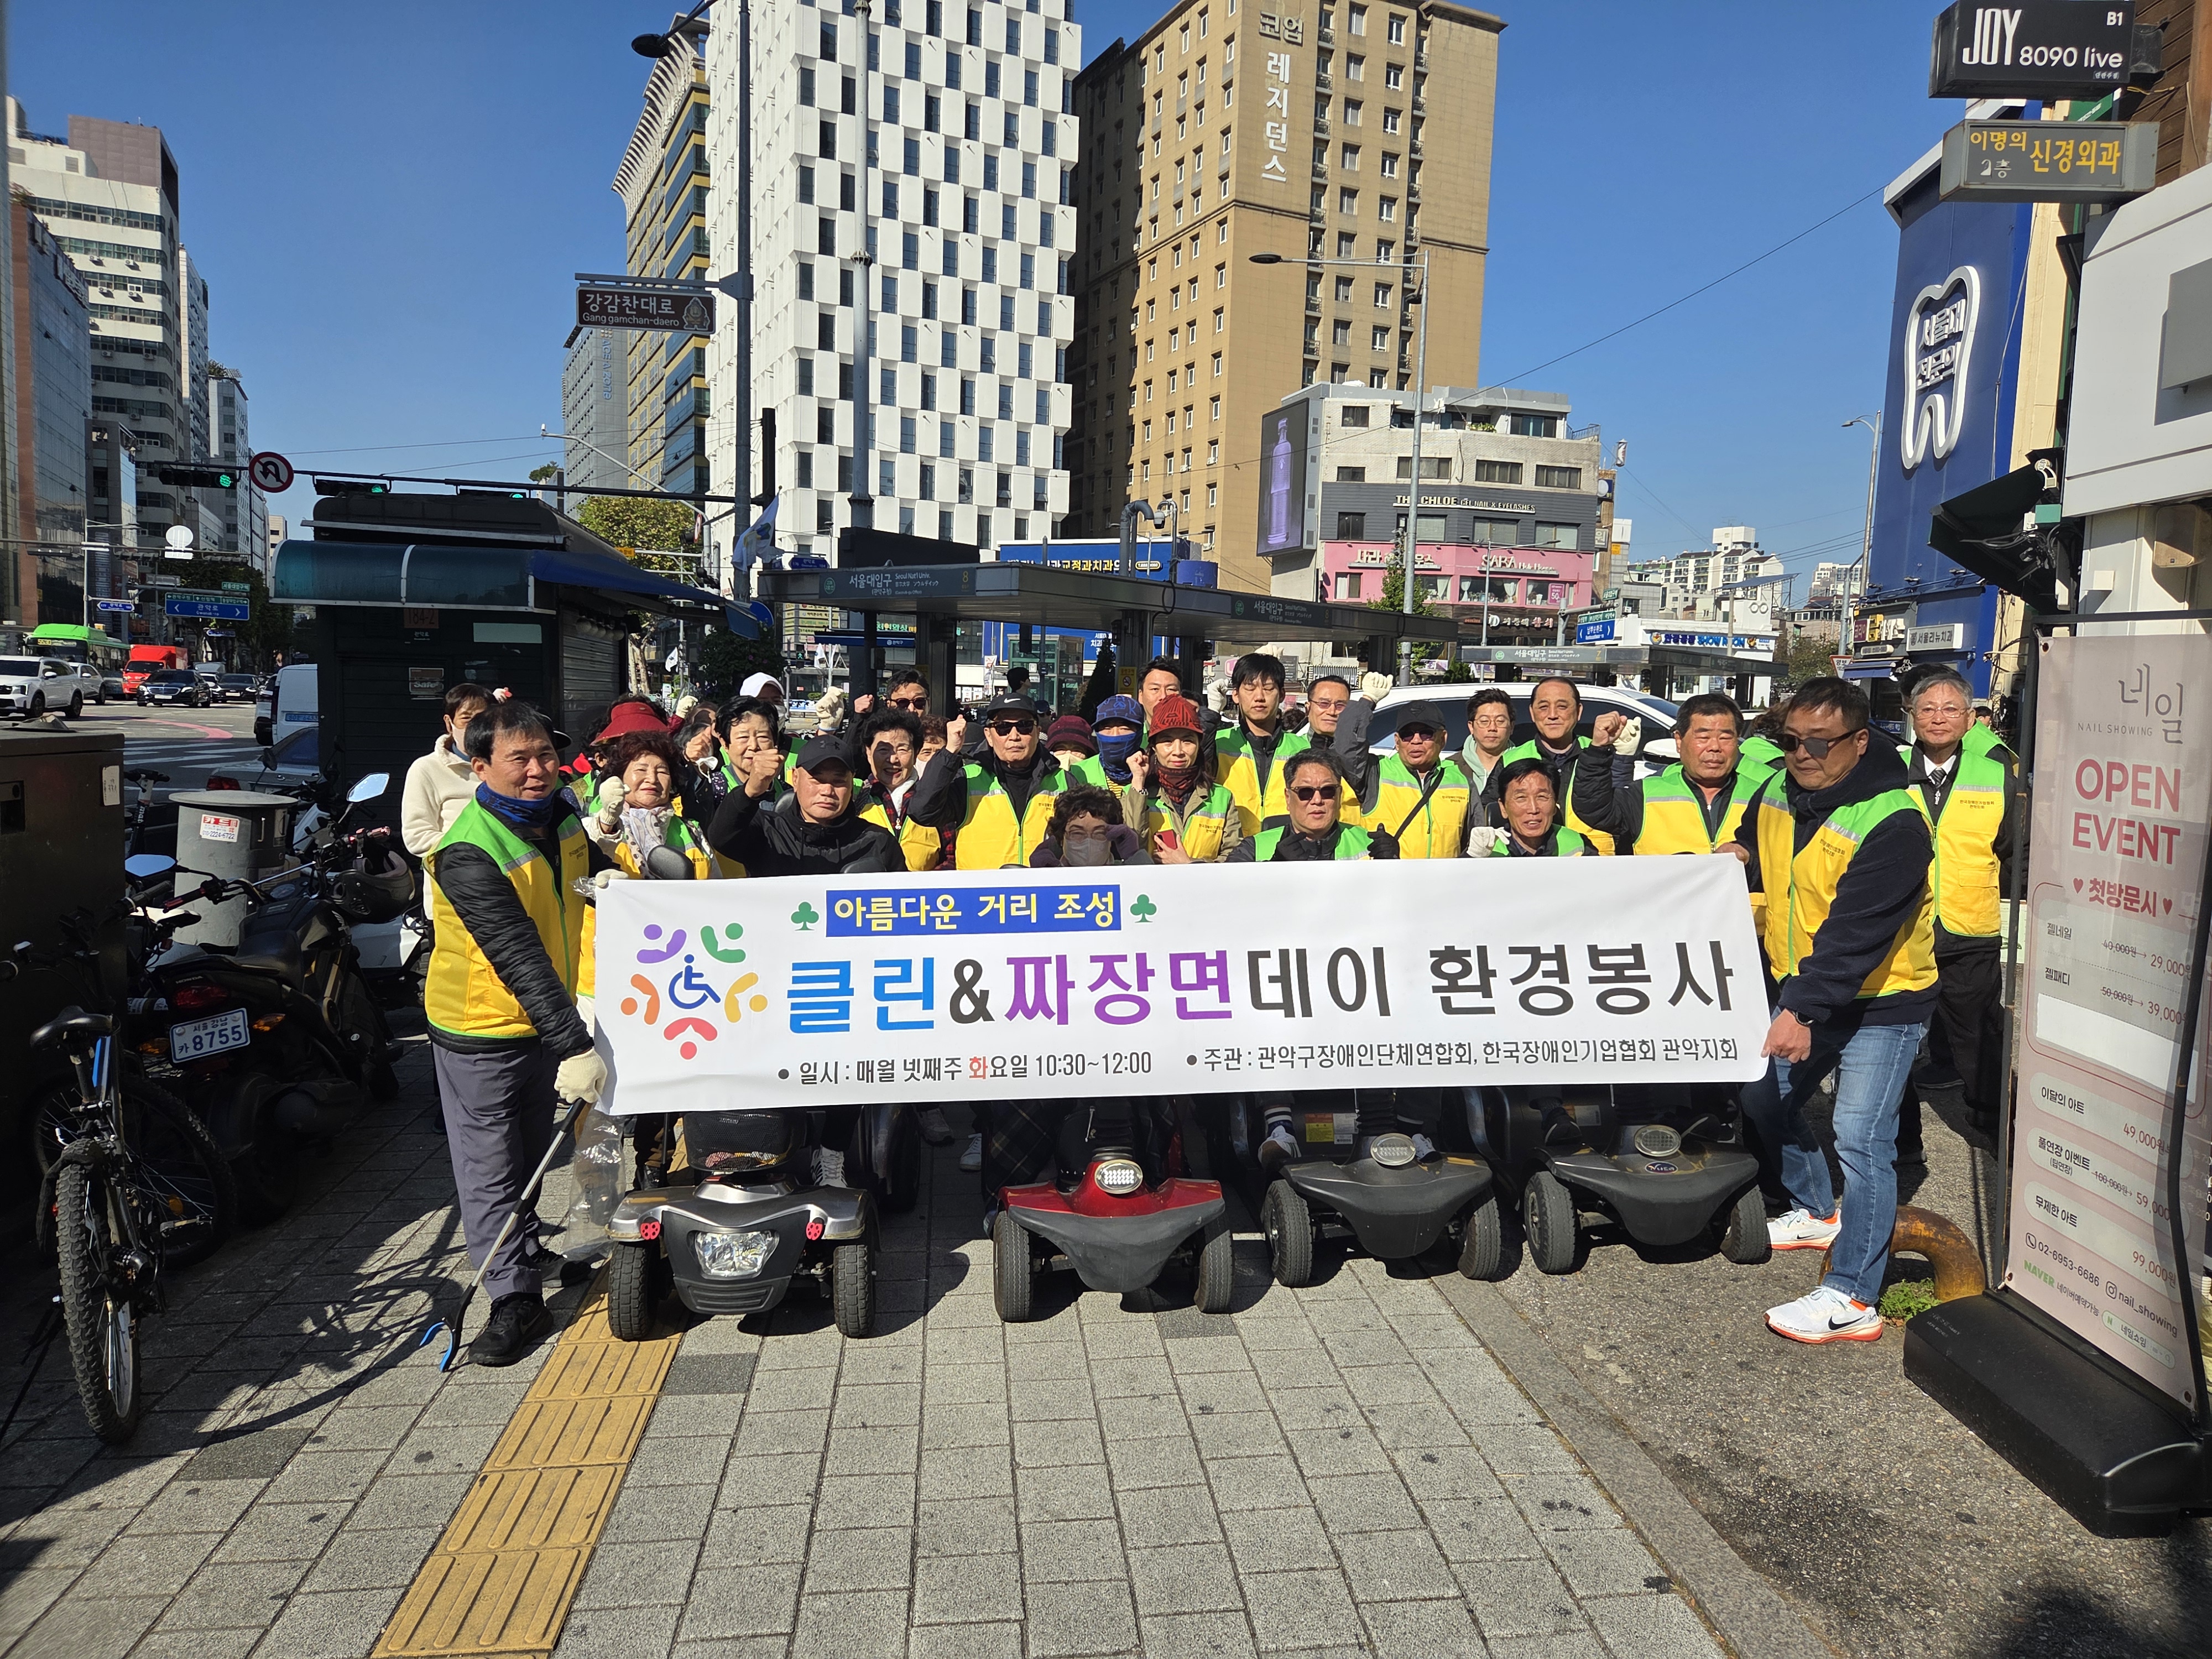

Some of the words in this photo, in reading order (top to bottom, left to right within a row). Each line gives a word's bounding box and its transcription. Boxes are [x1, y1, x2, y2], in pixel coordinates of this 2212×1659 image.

[2106, 12, 2122, 25] B1
[1963, 8, 2022, 65] JOY
[2020, 46, 2077, 66] 8090
[2084, 48, 2122, 68] live
[1262, 52, 1290, 182] 레지던스
[1970, 131, 2027, 151] 이명의
[2030, 140, 2121, 174] 신경외과
[585, 294, 675, 315] 강감찬대로
[1421, 495, 1458, 505] CHLOE
[1498, 502, 1536, 512] EYELASHES
[1481, 554, 1517, 568] SARA
[849, 573, 892, 588] 서울대입구
[962, 571, 969, 582] 8
[1254, 601, 1283, 615] 서울대입구
[2118, 663, 2184, 745] 네일
[2077, 721, 2103, 733] NAIL
[2106, 724, 2153, 737] SHOWING
[2075, 759, 2180, 812] OPEN
[2072, 812, 2180, 865] EVENT
[834, 893, 962, 930] 아름다운
[977, 893, 1038, 925] 거리
[1053, 891, 1114, 928] 조성
[2088, 878, 2157, 917] 첫방문시
[2047, 922, 2072, 940] 젤네일
[2102, 940, 2137, 958] 40,000원
[787, 946, 1392, 1034] 클린&짜장면데이
[1428, 940, 1735, 1017] 환경봉사
[2045, 966, 2070, 986] 젤패디
[193, 1020, 209, 1032] 서울
[210, 1016, 228, 1029] 강남
[2147, 1001, 2186, 1025] 39,000
[179, 1043, 190, 1054] 카
[192, 1025, 243, 1052] 8755
[1257, 1041, 1478, 1069] 관악구장애인단체연합회,
[1483, 1039, 1656, 1065] 한국장애인기업협회
[1662, 1037, 1739, 1062] 관악지회
[856, 1058, 896, 1082] 매월
[902, 1057, 962, 1082] 넷째주
[969, 1055, 1028, 1079] 화요일
[1035, 1051, 1152, 1077] 10:30~12:00
[2041, 1086, 2066, 1107] 이달의
[2068, 1099, 2085, 1115] 아트
[2038, 1136, 2063, 1157] 풀연장
[2064, 1147, 2090, 1171] 이벤트
[2049, 1158, 2073, 1177] (팁연장)
[2035, 1195, 2060, 1217] 무제한
[2060, 1208, 2078, 1228] 아트
[2038, 1241, 2100, 1287] 02-6953-6686
[2132, 1250, 2177, 1290] 99,000원
[2024, 1260, 2055, 1288] NAVER
[2057, 1281, 2100, 1317] 네이버예약가능
[2118, 1290, 2178, 1338] nail_showing
[2120, 1324, 2147, 1348] 네일쇼잉
